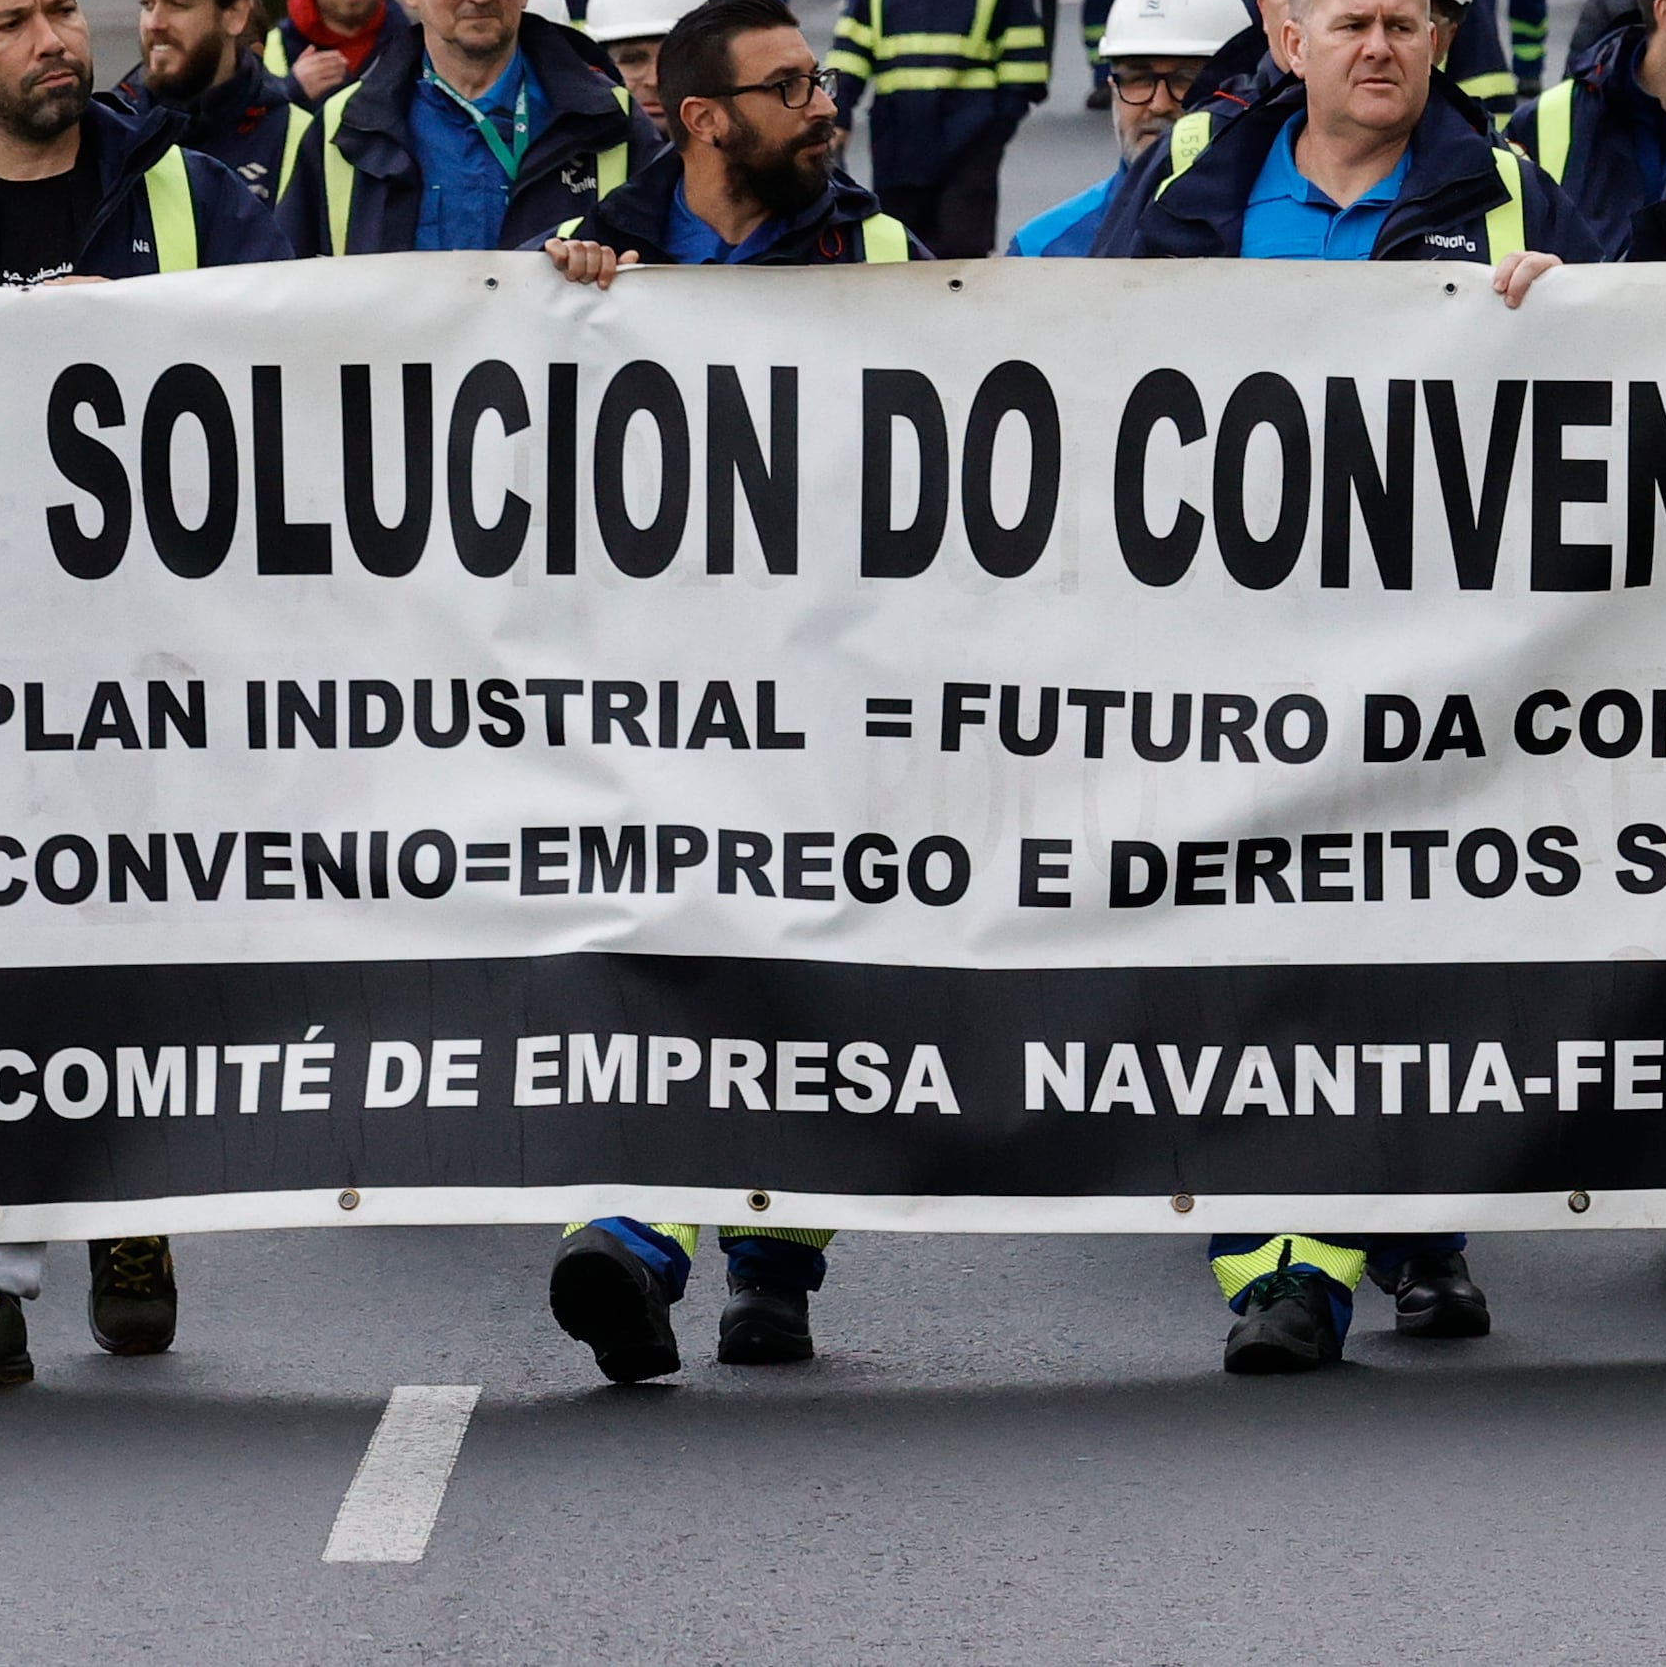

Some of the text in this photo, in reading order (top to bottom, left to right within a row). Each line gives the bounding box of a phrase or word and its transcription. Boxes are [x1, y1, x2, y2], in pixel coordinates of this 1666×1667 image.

[46, 359, 799, 580] SOLUCION
[860, 359, 1061, 579] DO
[246, 678, 806, 750] INDUSTRIAL
[940, 682, 1328, 765] FUTURO
[1363, 693, 1487, 763] DA
[1018, 838, 1072, 909] E
[1108, 825, 1582, 909] DEREITOS
[363, 1038, 483, 1109] DE
[513, 1032, 962, 1115] EMPRESA
